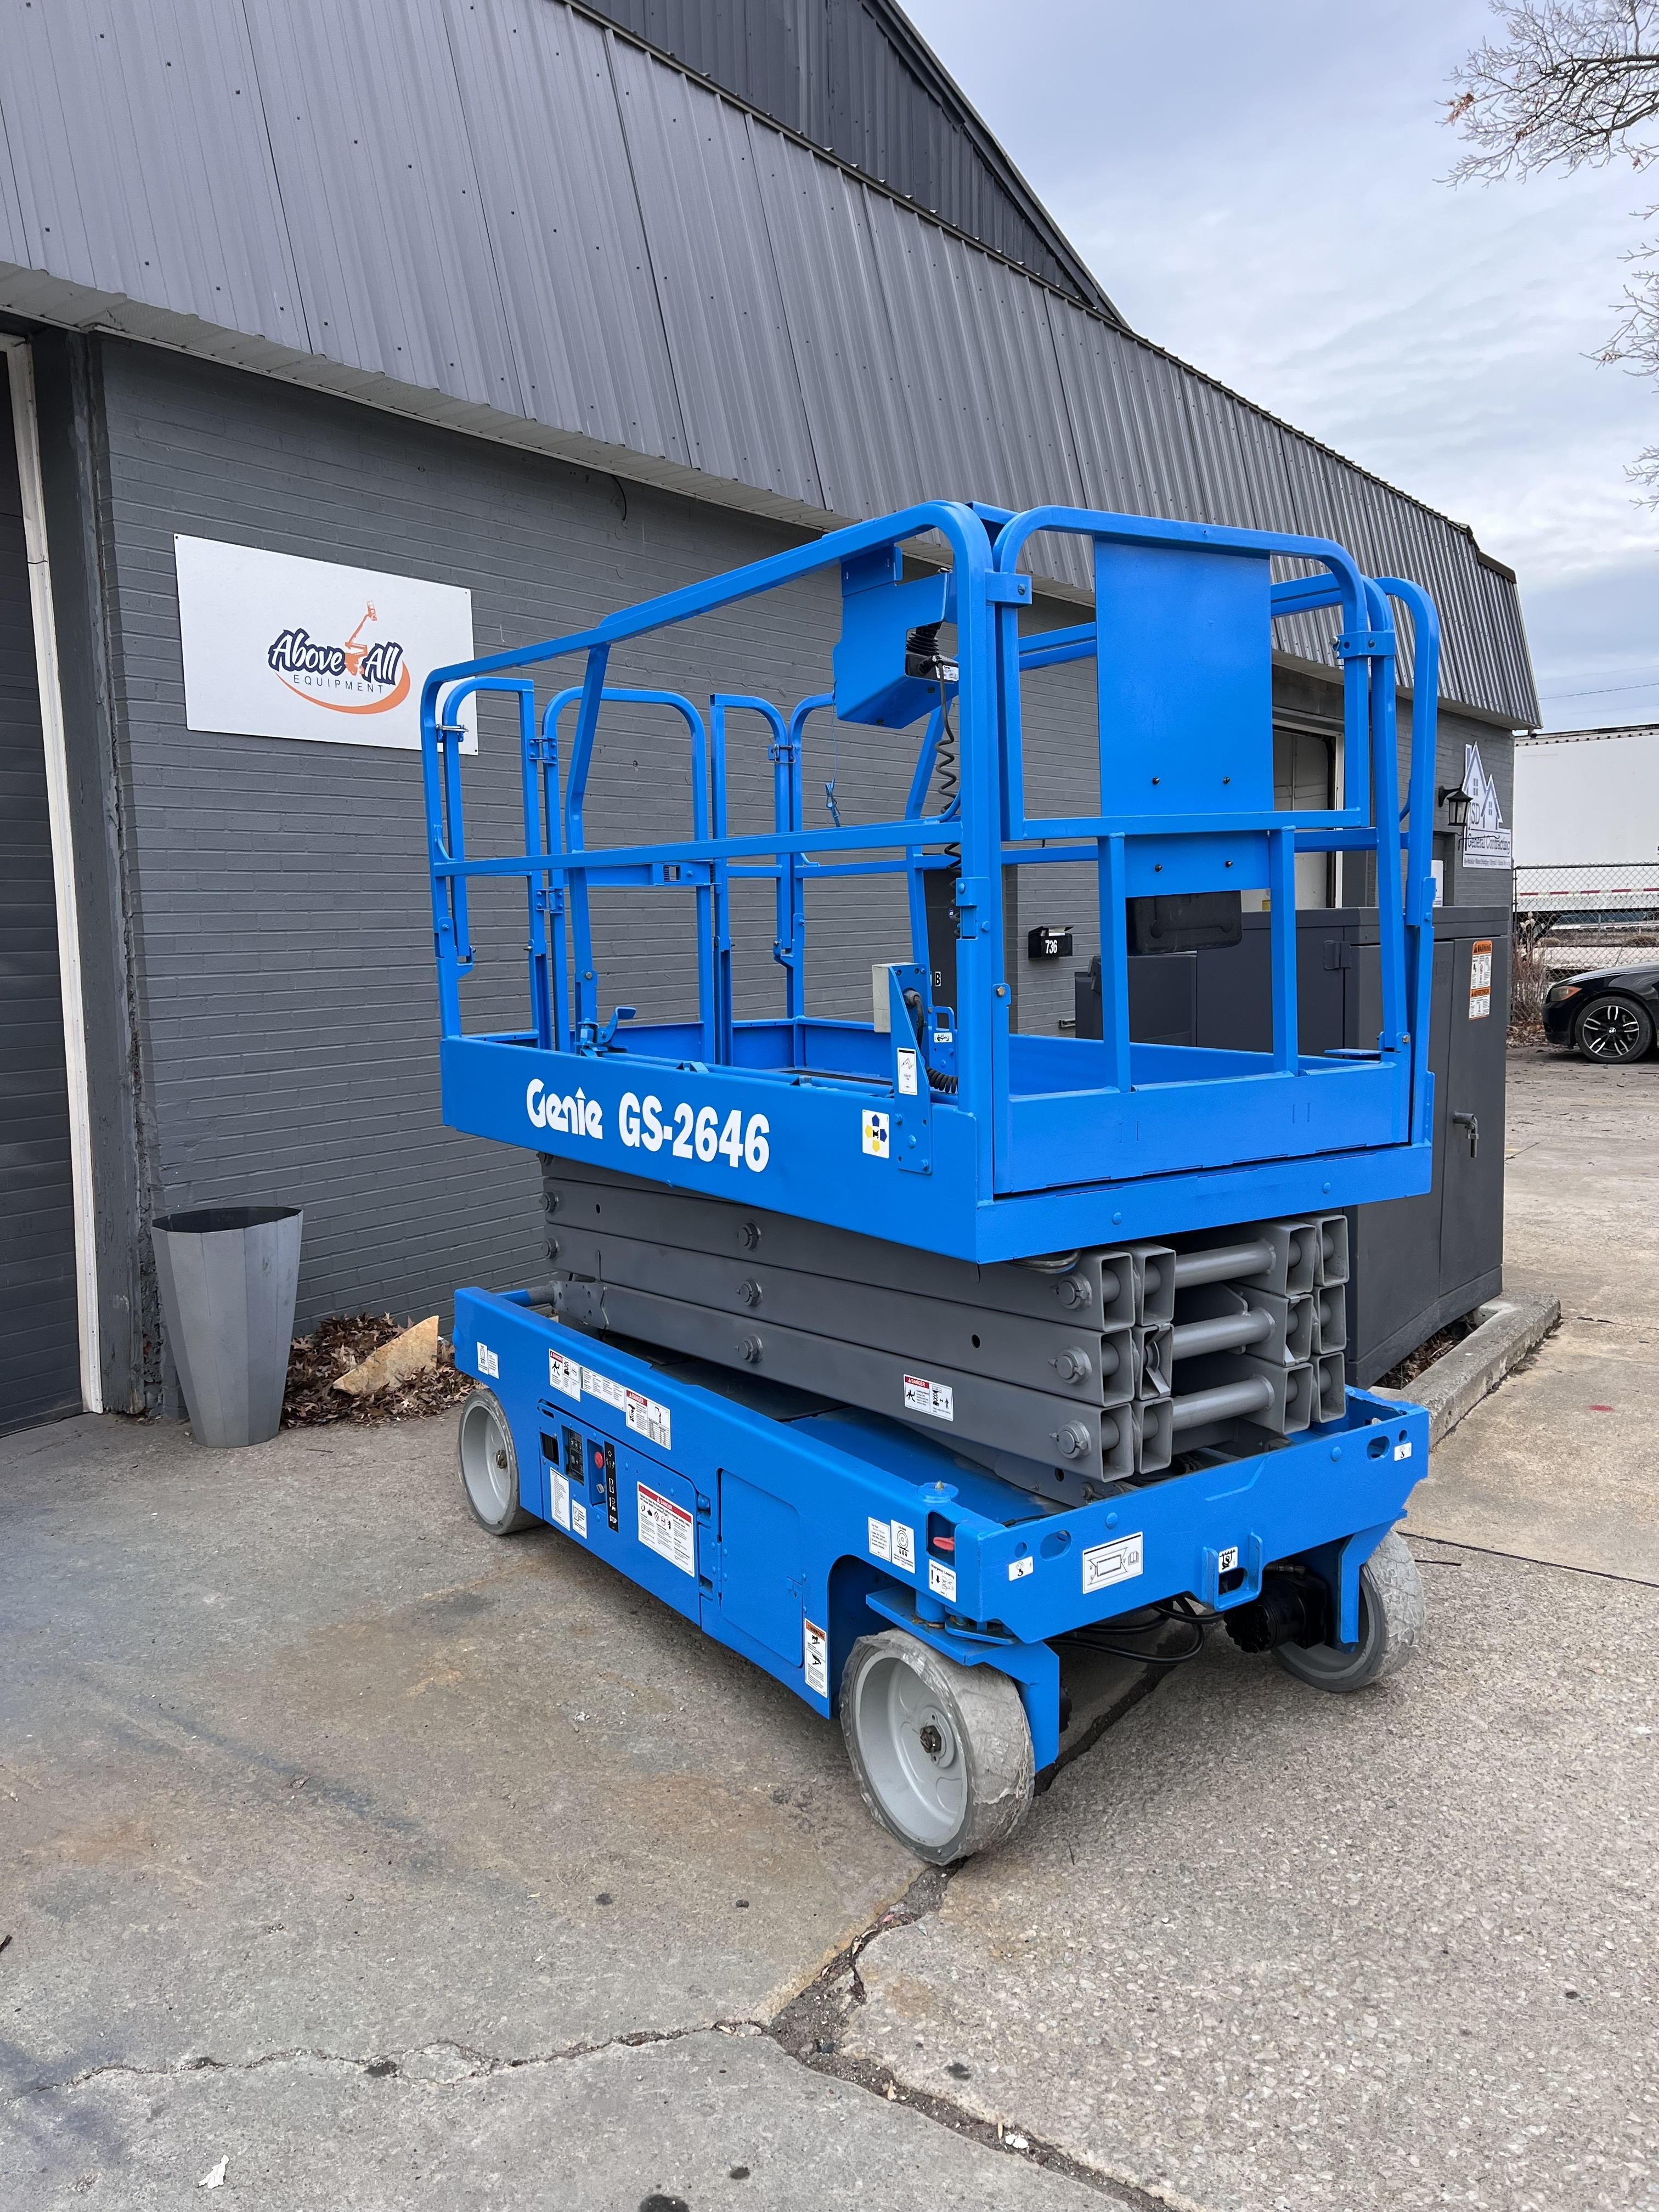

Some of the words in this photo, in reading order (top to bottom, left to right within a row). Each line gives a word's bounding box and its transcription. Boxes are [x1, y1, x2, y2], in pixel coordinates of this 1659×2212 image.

[268, 629, 346, 676] Above
[362, 642, 403, 685] All
[294, 675, 383, 694] EQUIPMENT
[1468, 833, 1485, 848] General
[1045, 939, 1058, 954] 736
[935, 972, 941, 986] B
[526, 1078, 603, 1139] Genie
[618, 1092, 770, 1172] GS-2646
[911, 1379, 926, 1387] DANGER
